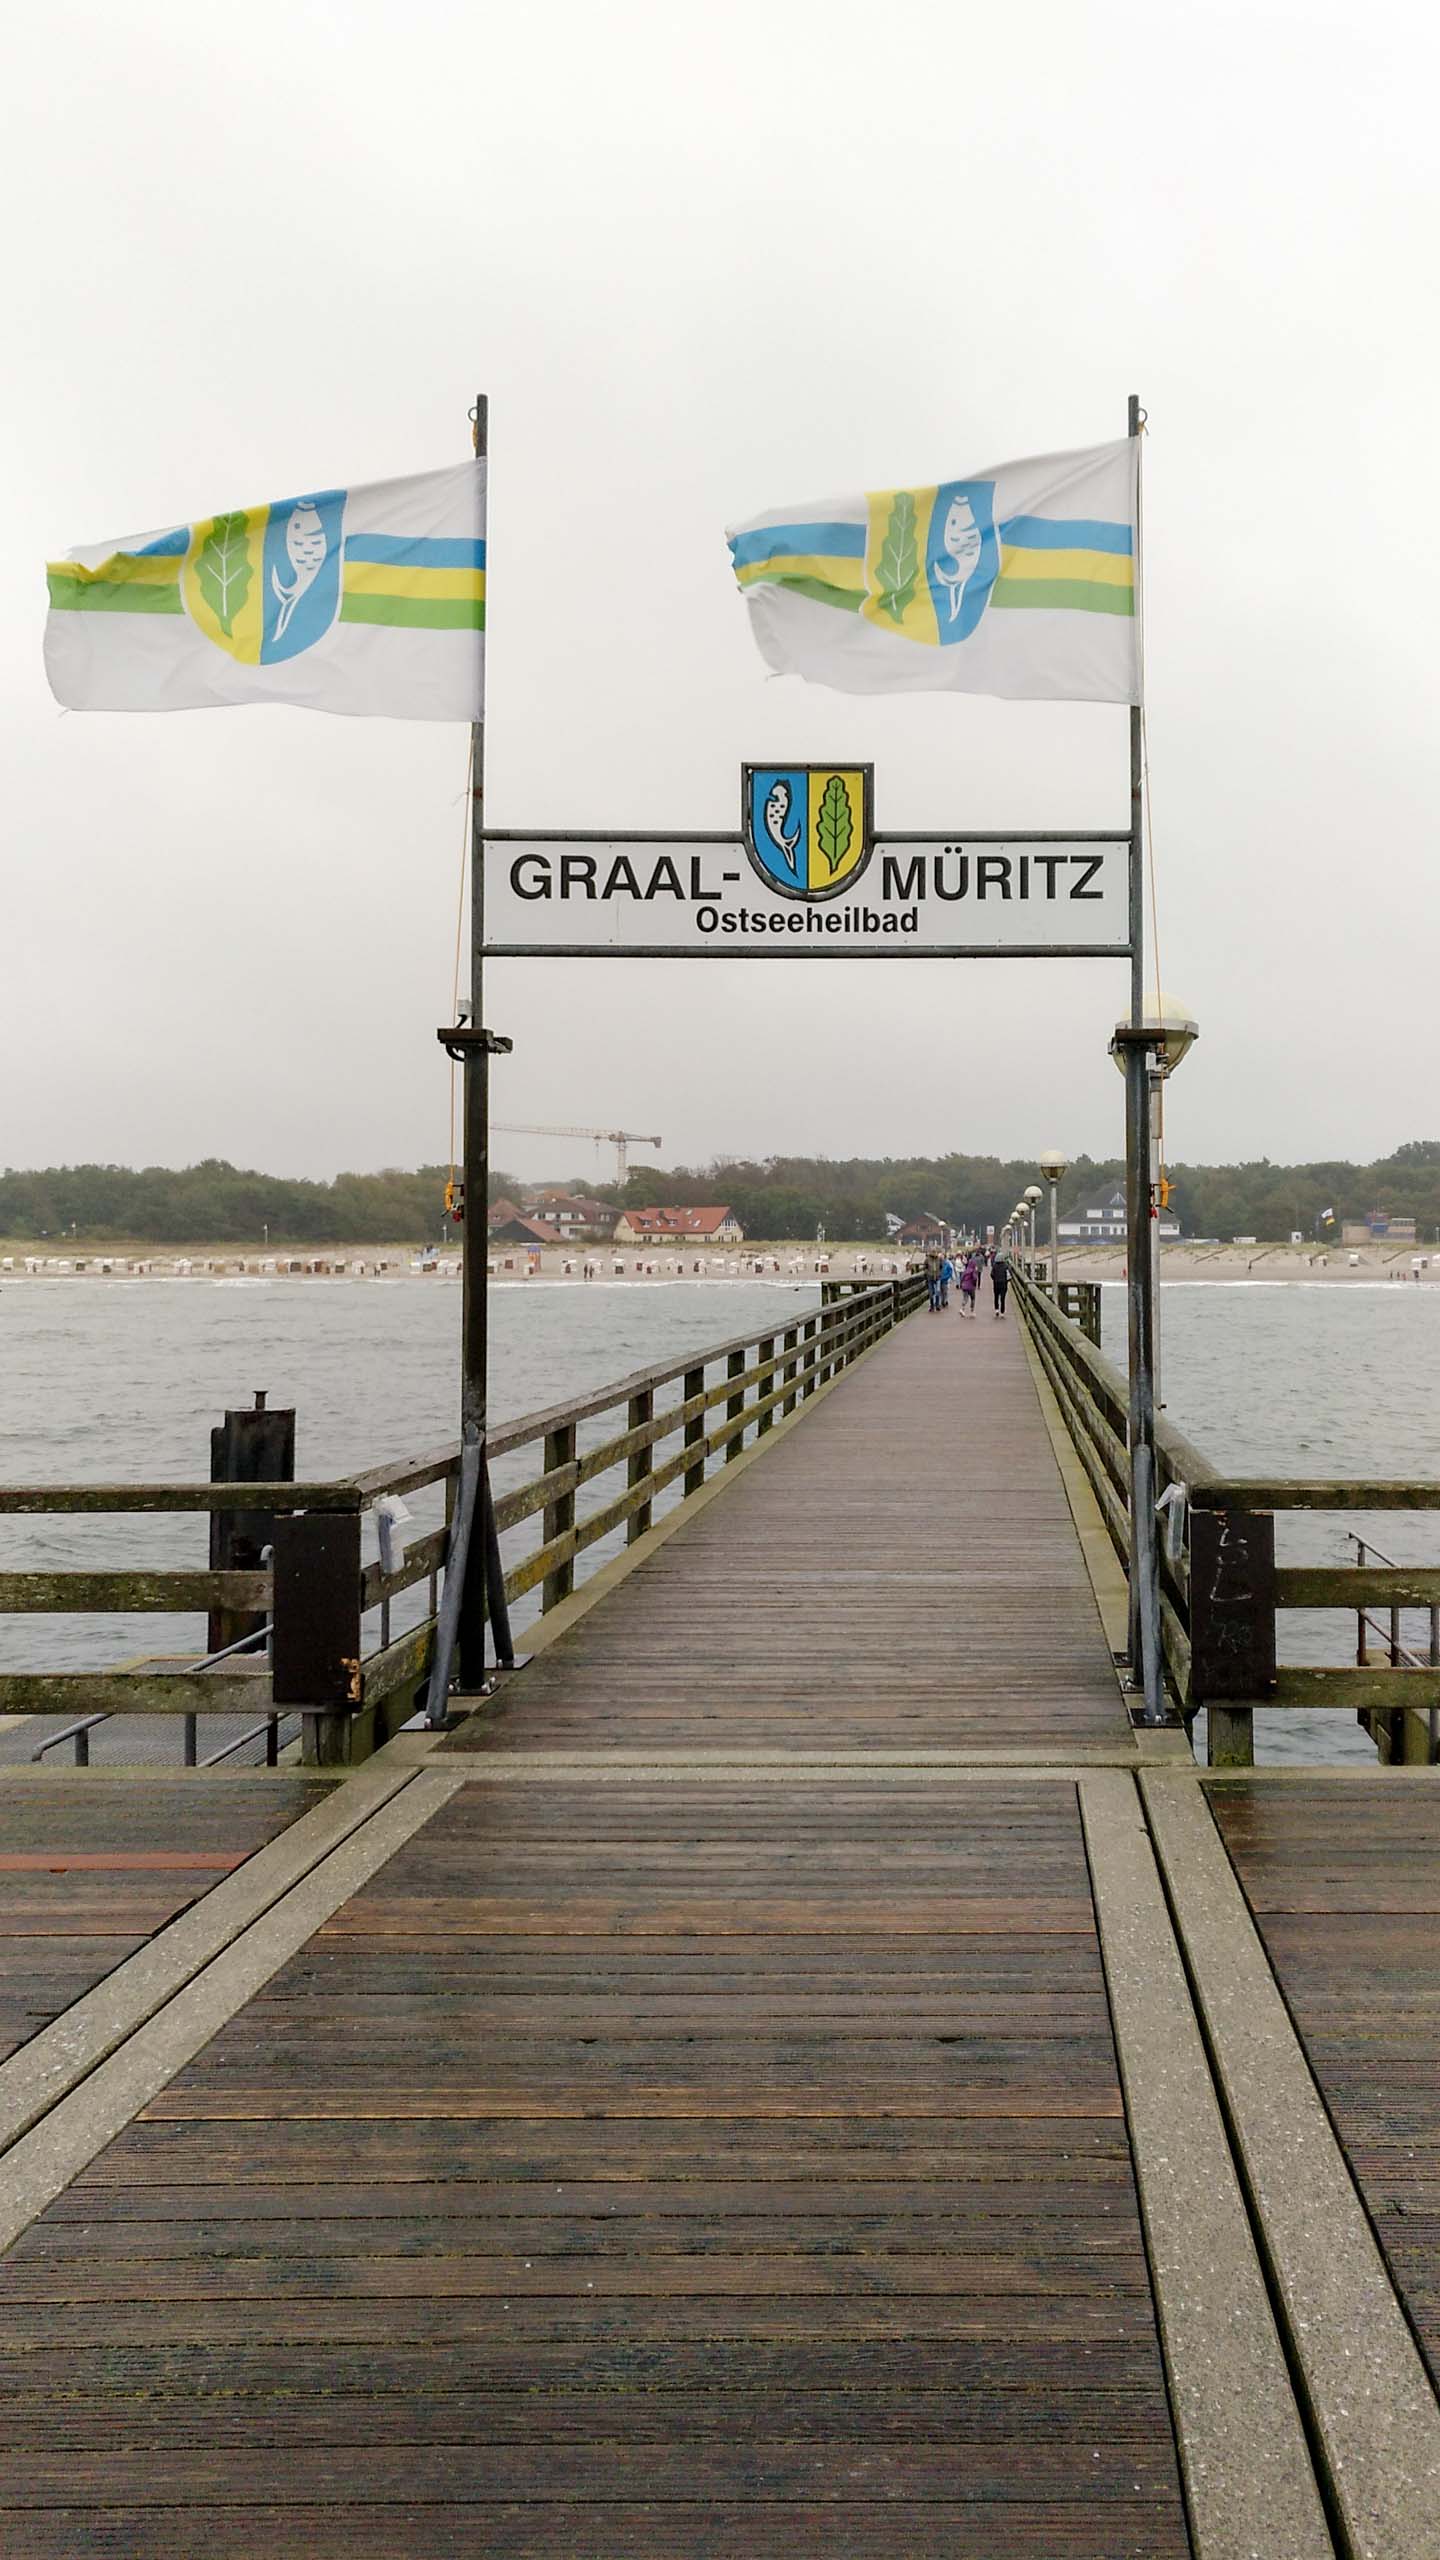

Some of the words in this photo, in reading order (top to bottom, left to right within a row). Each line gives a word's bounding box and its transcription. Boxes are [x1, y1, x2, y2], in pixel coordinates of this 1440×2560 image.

[509, 853, 741, 901] GRAAL-
[882, 845, 1104, 902] MÜRITZ
[695, 905, 919, 934] Ostseeheilbad
